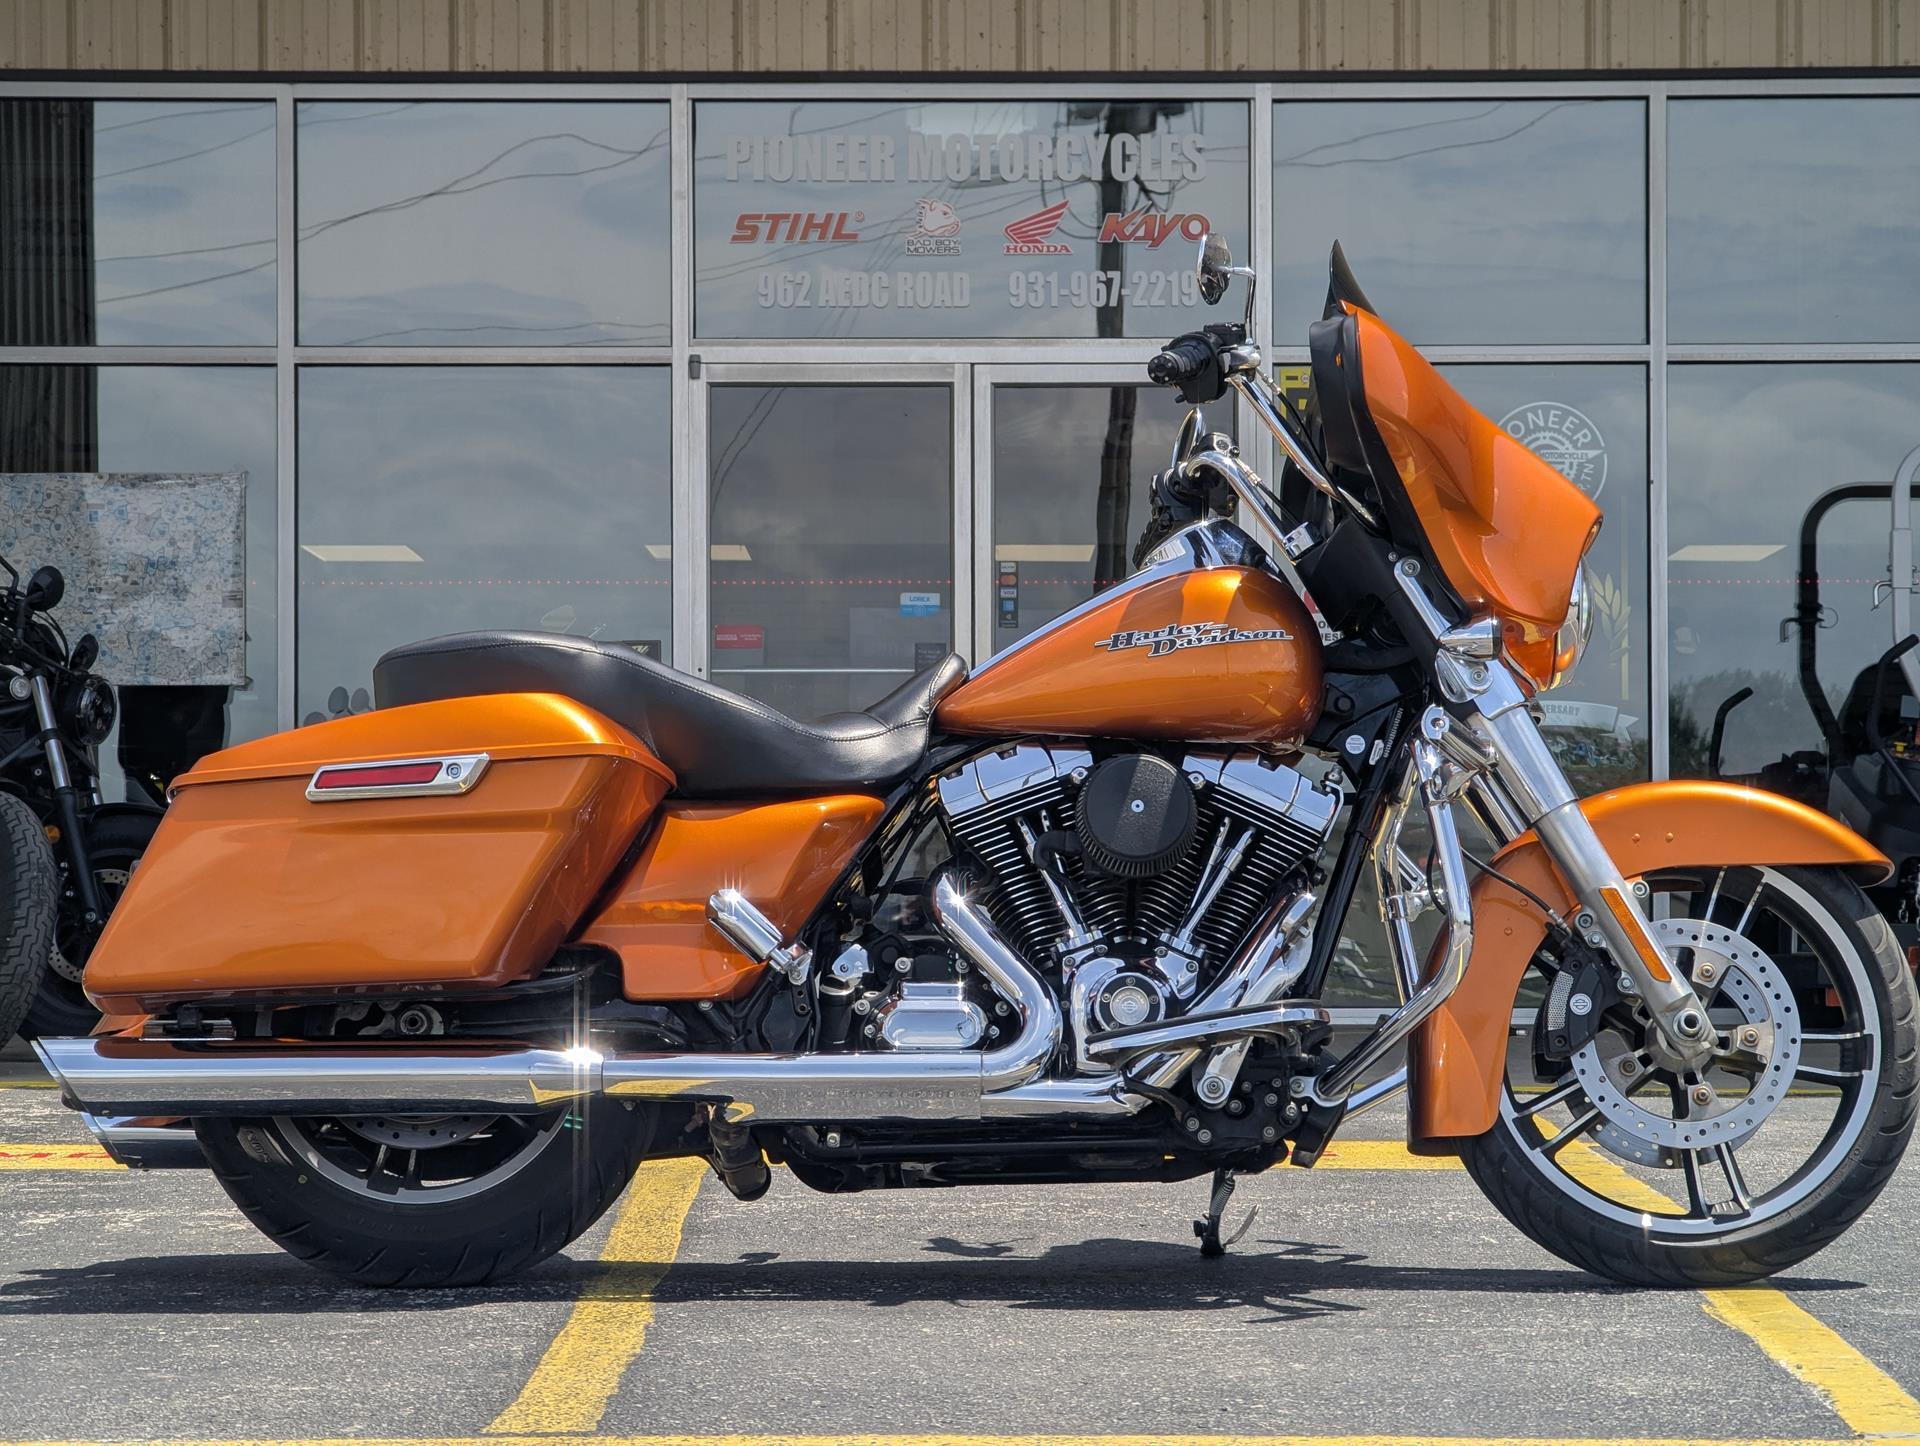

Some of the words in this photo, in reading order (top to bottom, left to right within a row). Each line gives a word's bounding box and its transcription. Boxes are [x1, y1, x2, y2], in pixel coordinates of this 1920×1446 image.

[726, 134, 897, 183] PIONEER
[907, 132, 1207, 183] MOTORCYCLES
[730, 211, 860, 243] STIHL
[1098, 201, 1211, 249] KAYO
[906, 238, 932, 247] BAD
[934, 238, 960, 247] BOY
[906, 246, 961, 255] MOWERS
[1005, 244, 1071, 254] HONDA
[757, 271, 813, 309] 962
[816, 271, 890, 309] AEDC
[896, 271, 971, 309] ROAD
[1008, 270, 1199, 309] 931-967-2219
[1506, 409, 1592, 448] ONEER
[1096, 622, 1228, 651] Harley
[1148, 628, 1293, 657] Davidson
[1545, 704, 1581, 717] ERSARY
